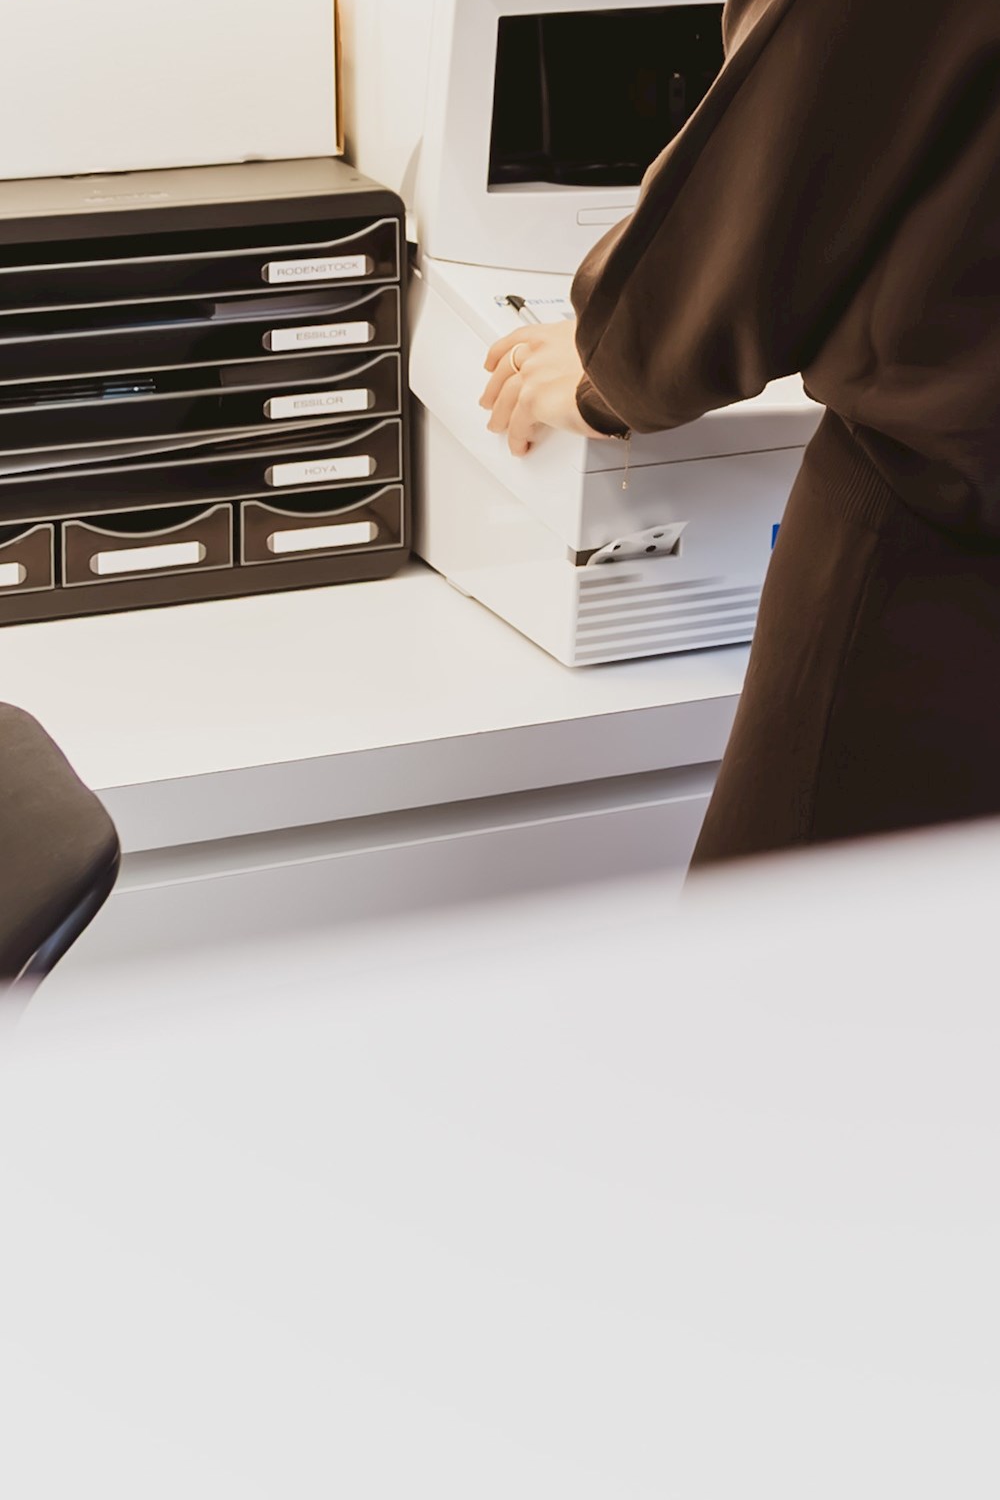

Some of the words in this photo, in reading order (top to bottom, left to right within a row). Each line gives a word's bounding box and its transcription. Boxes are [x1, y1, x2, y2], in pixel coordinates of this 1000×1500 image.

[277, 262, 359, 276] RODENSTOCK
[296, 329, 346, 341] ESSILOR
[293, 396, 344, 409] ESSILOR
[304, 465, 337, 476] HOYA
